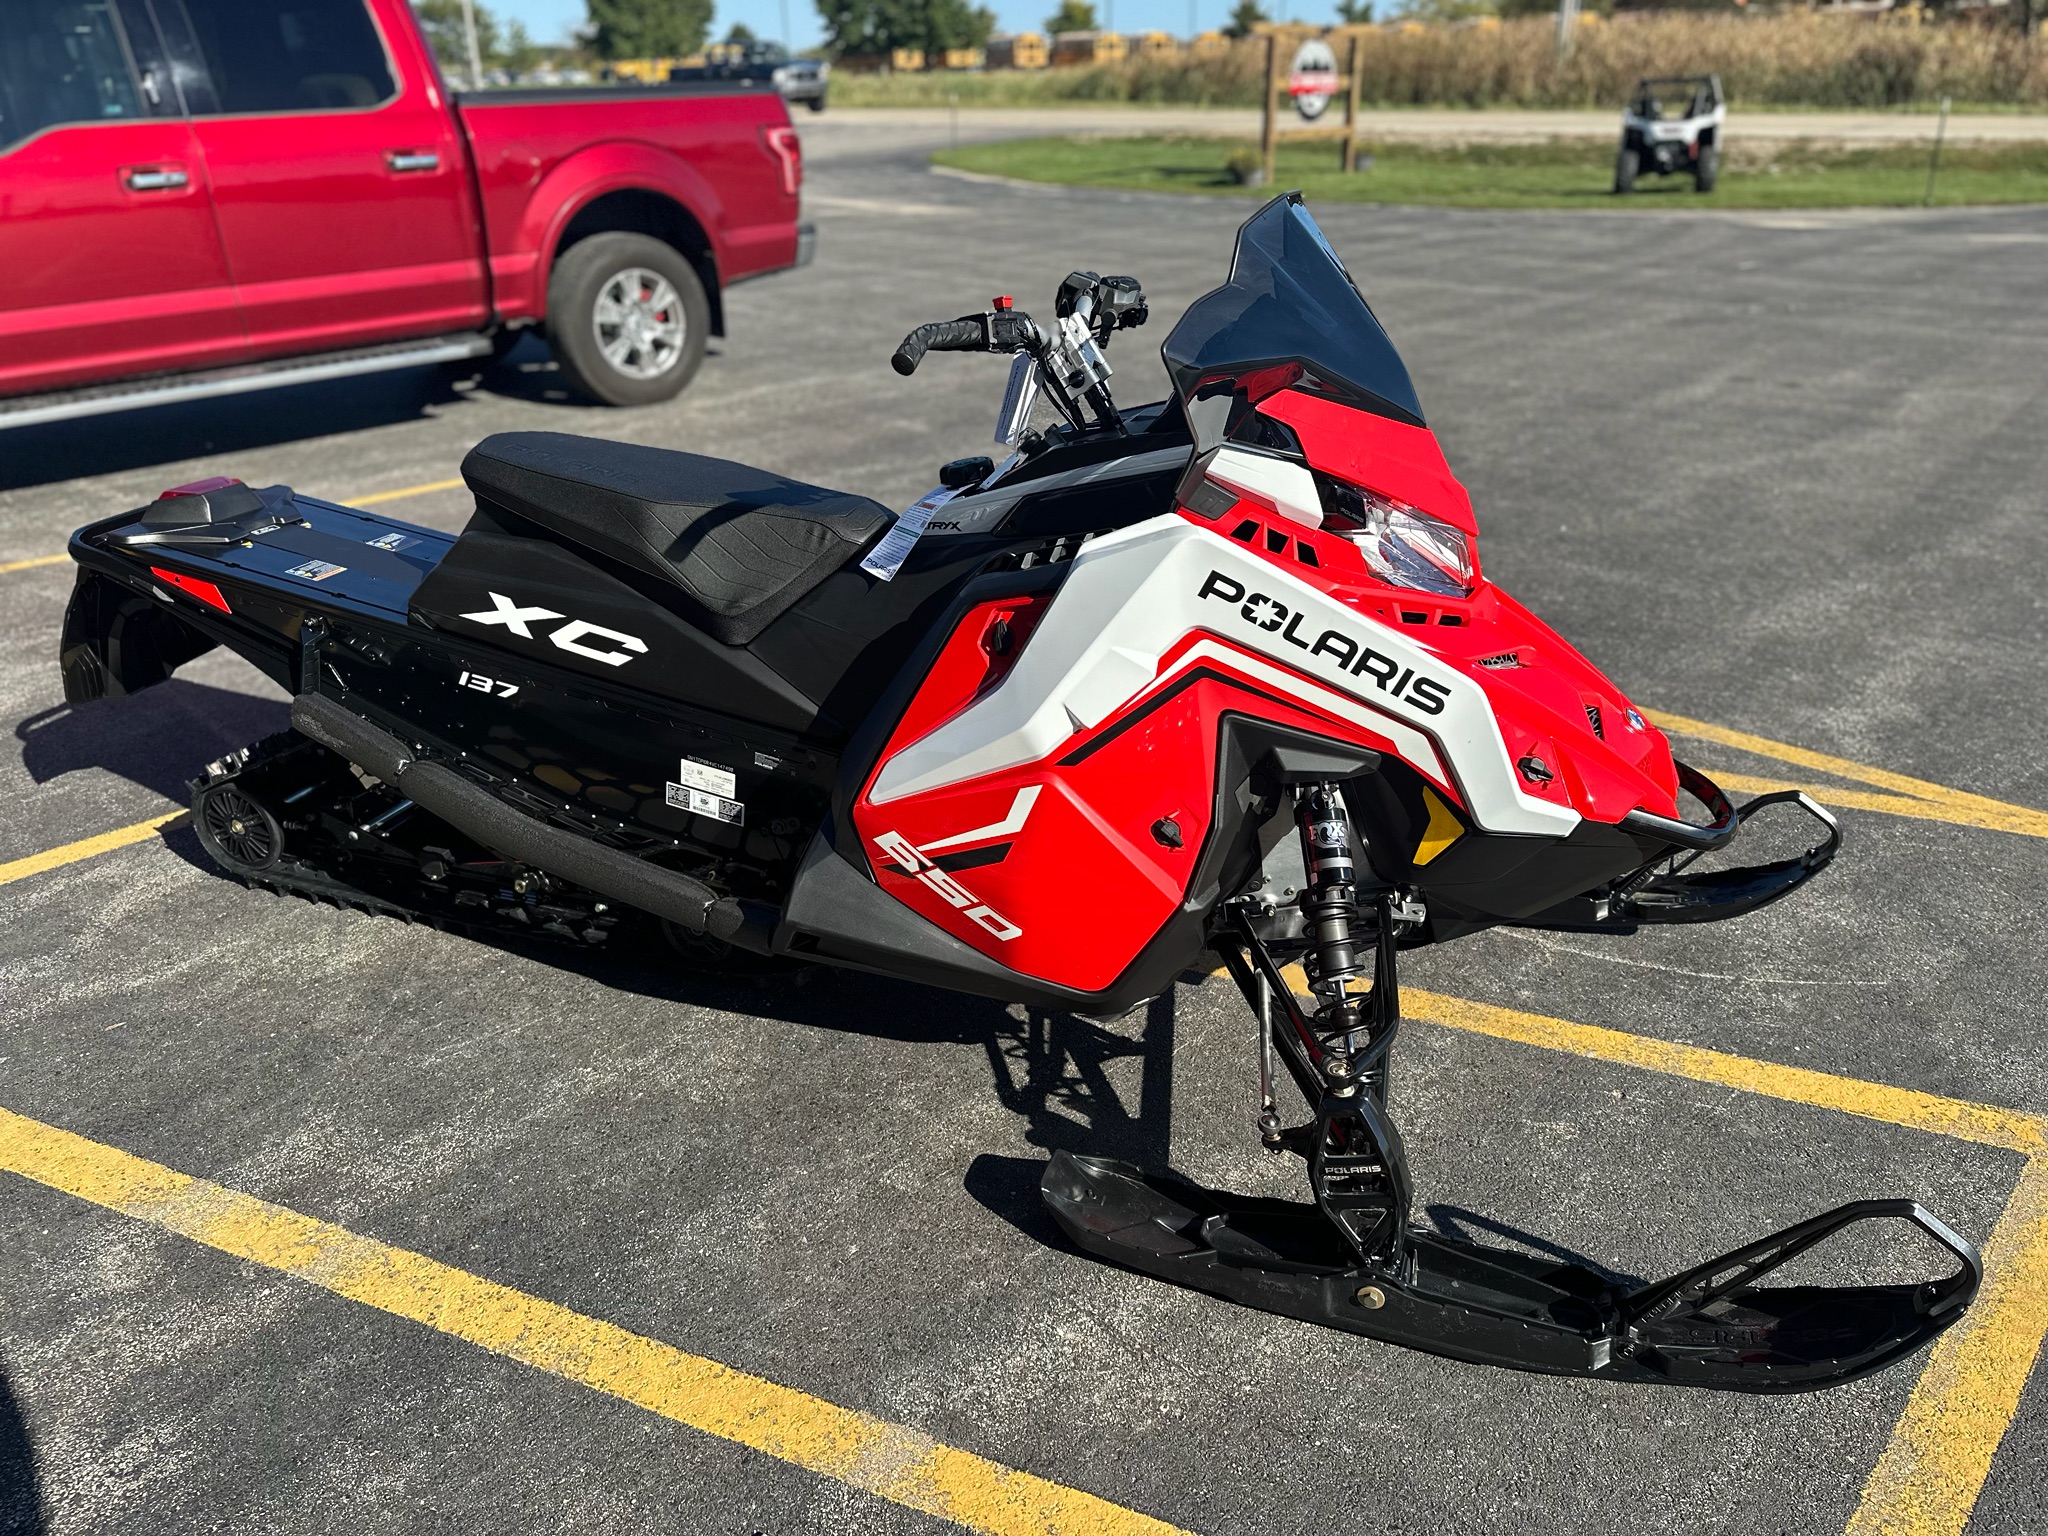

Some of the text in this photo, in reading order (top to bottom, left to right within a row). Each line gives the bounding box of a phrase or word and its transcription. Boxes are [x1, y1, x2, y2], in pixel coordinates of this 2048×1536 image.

[924, 521, 962, 532] TRYX
[458, 591, 649, 667] XC
[1197, 569, 1452, 716] POLARIS
[458, 671, 520, 698] 137
[1308, 821, 1345, 846] FOX
[872, 830, 1023, 942] 650
[1325, 1165, 1381, 1174] POLARIS
